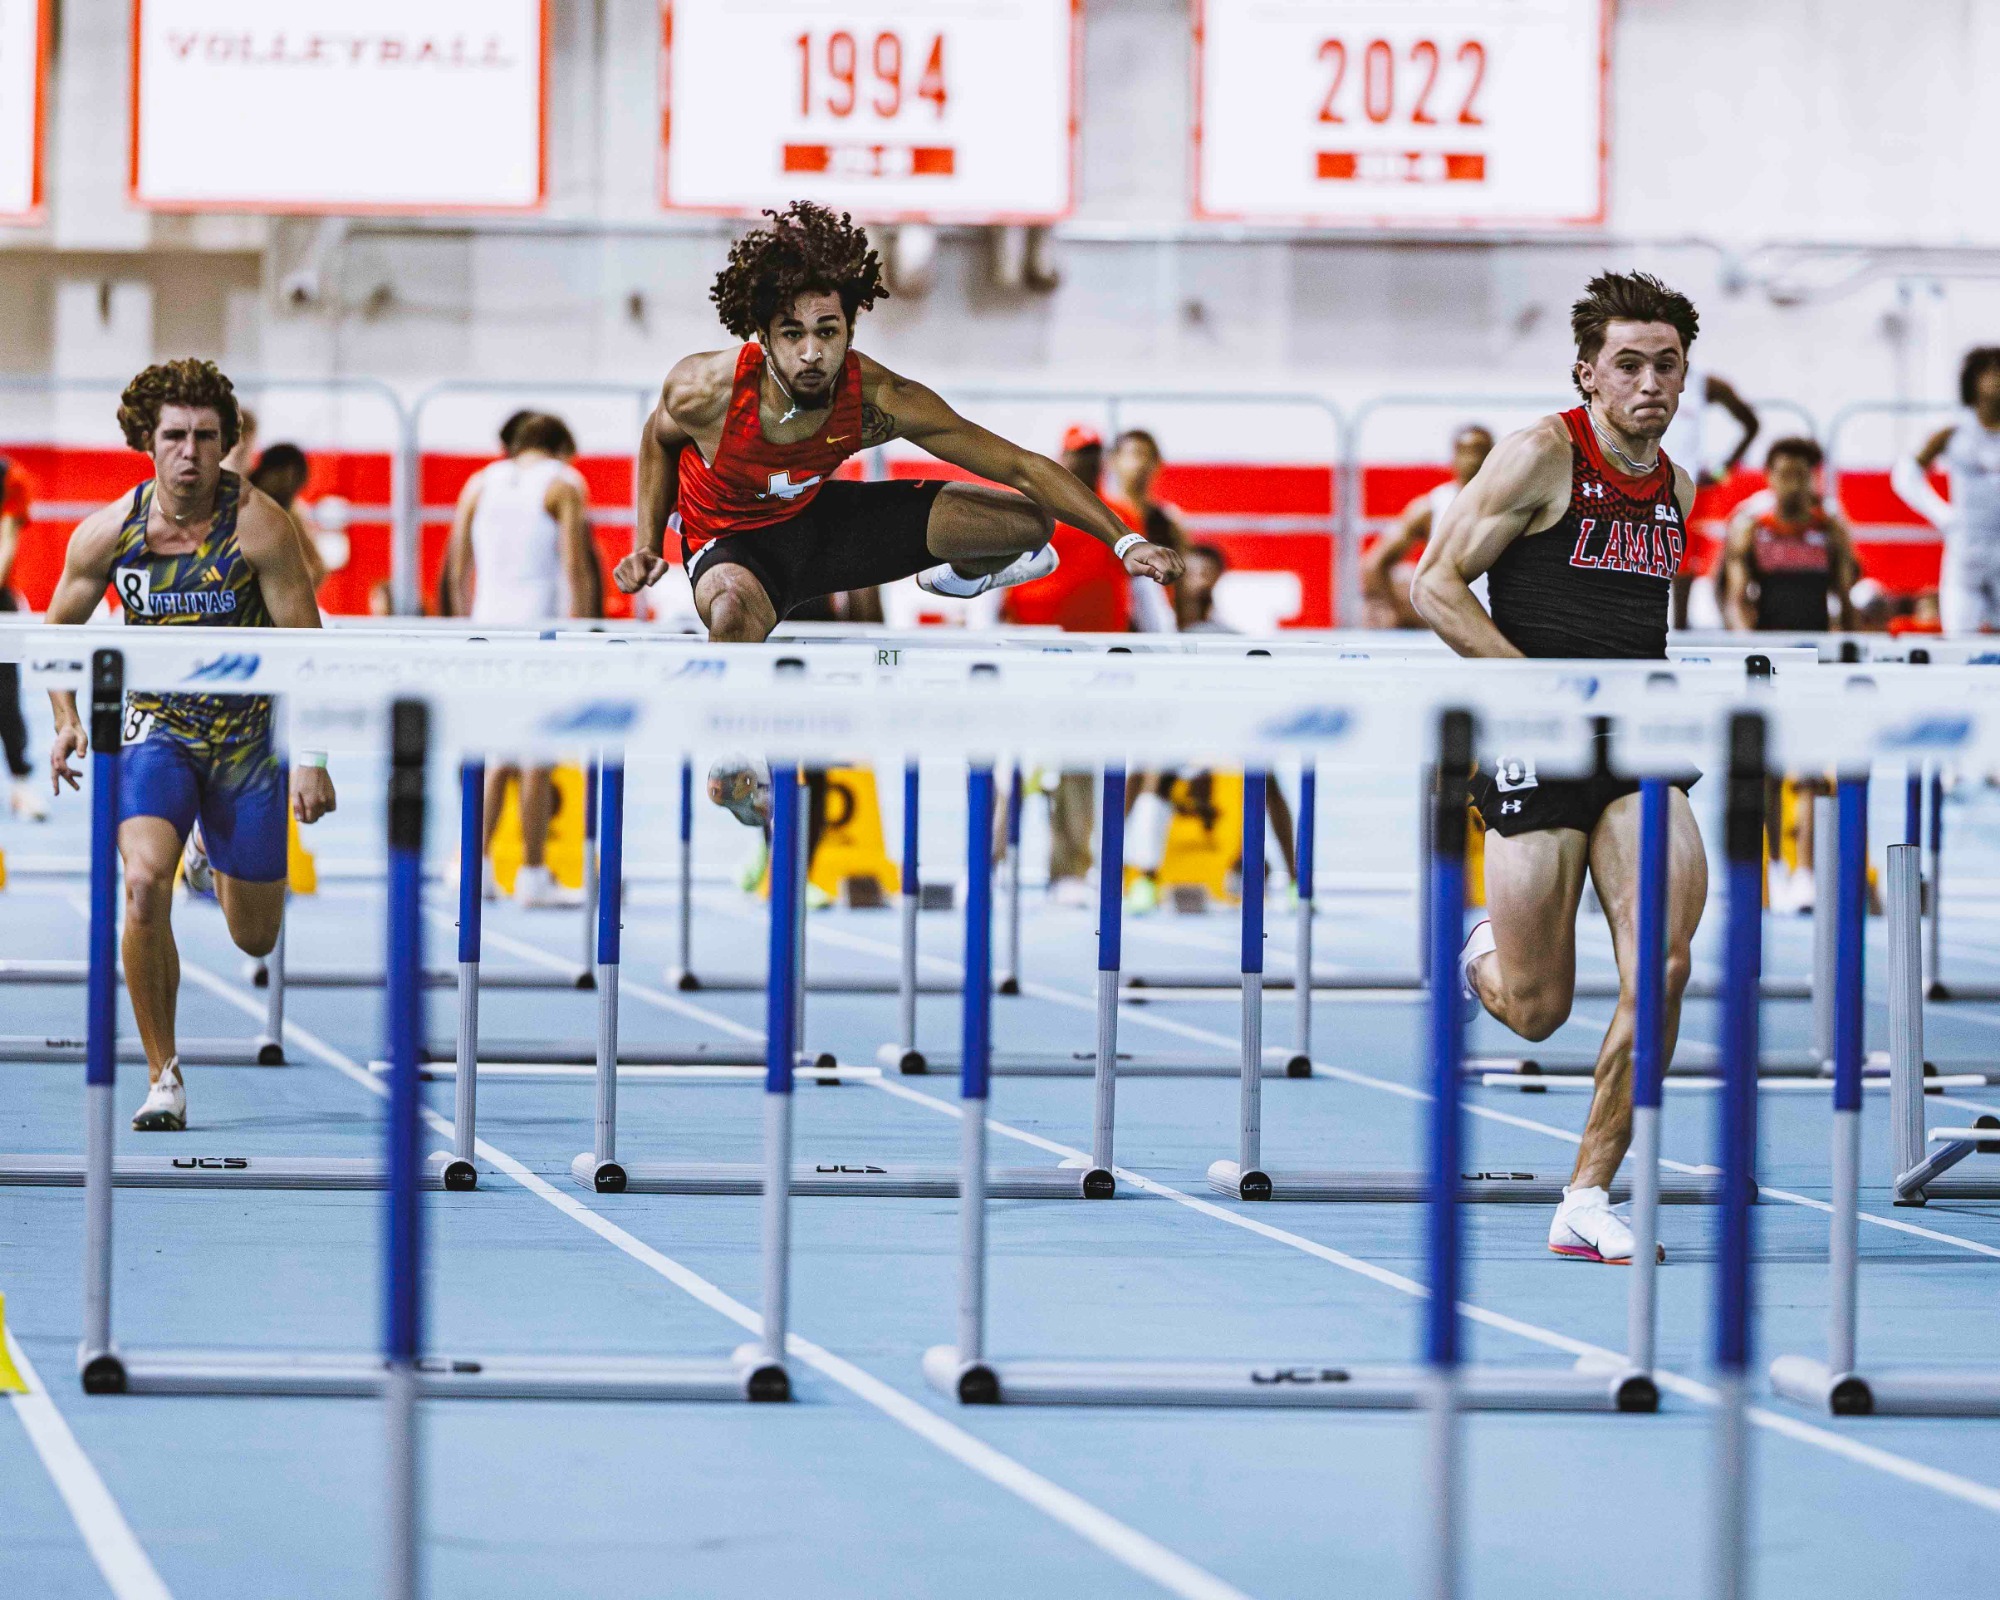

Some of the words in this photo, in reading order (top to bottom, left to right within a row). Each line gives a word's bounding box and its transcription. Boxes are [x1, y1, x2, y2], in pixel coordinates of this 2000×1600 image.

[167, 29, 513, 66] VOLLEYBALL
[797, 31, 949, 118] 1994
[1317, 39, 1487, 125] 2022
[1569, 518, 1683, 579] LAMAR
[123, 573, 145, 611] 8
[873, 649, 902, 666] RT
[172, 1157, 249, 1169] UCS
